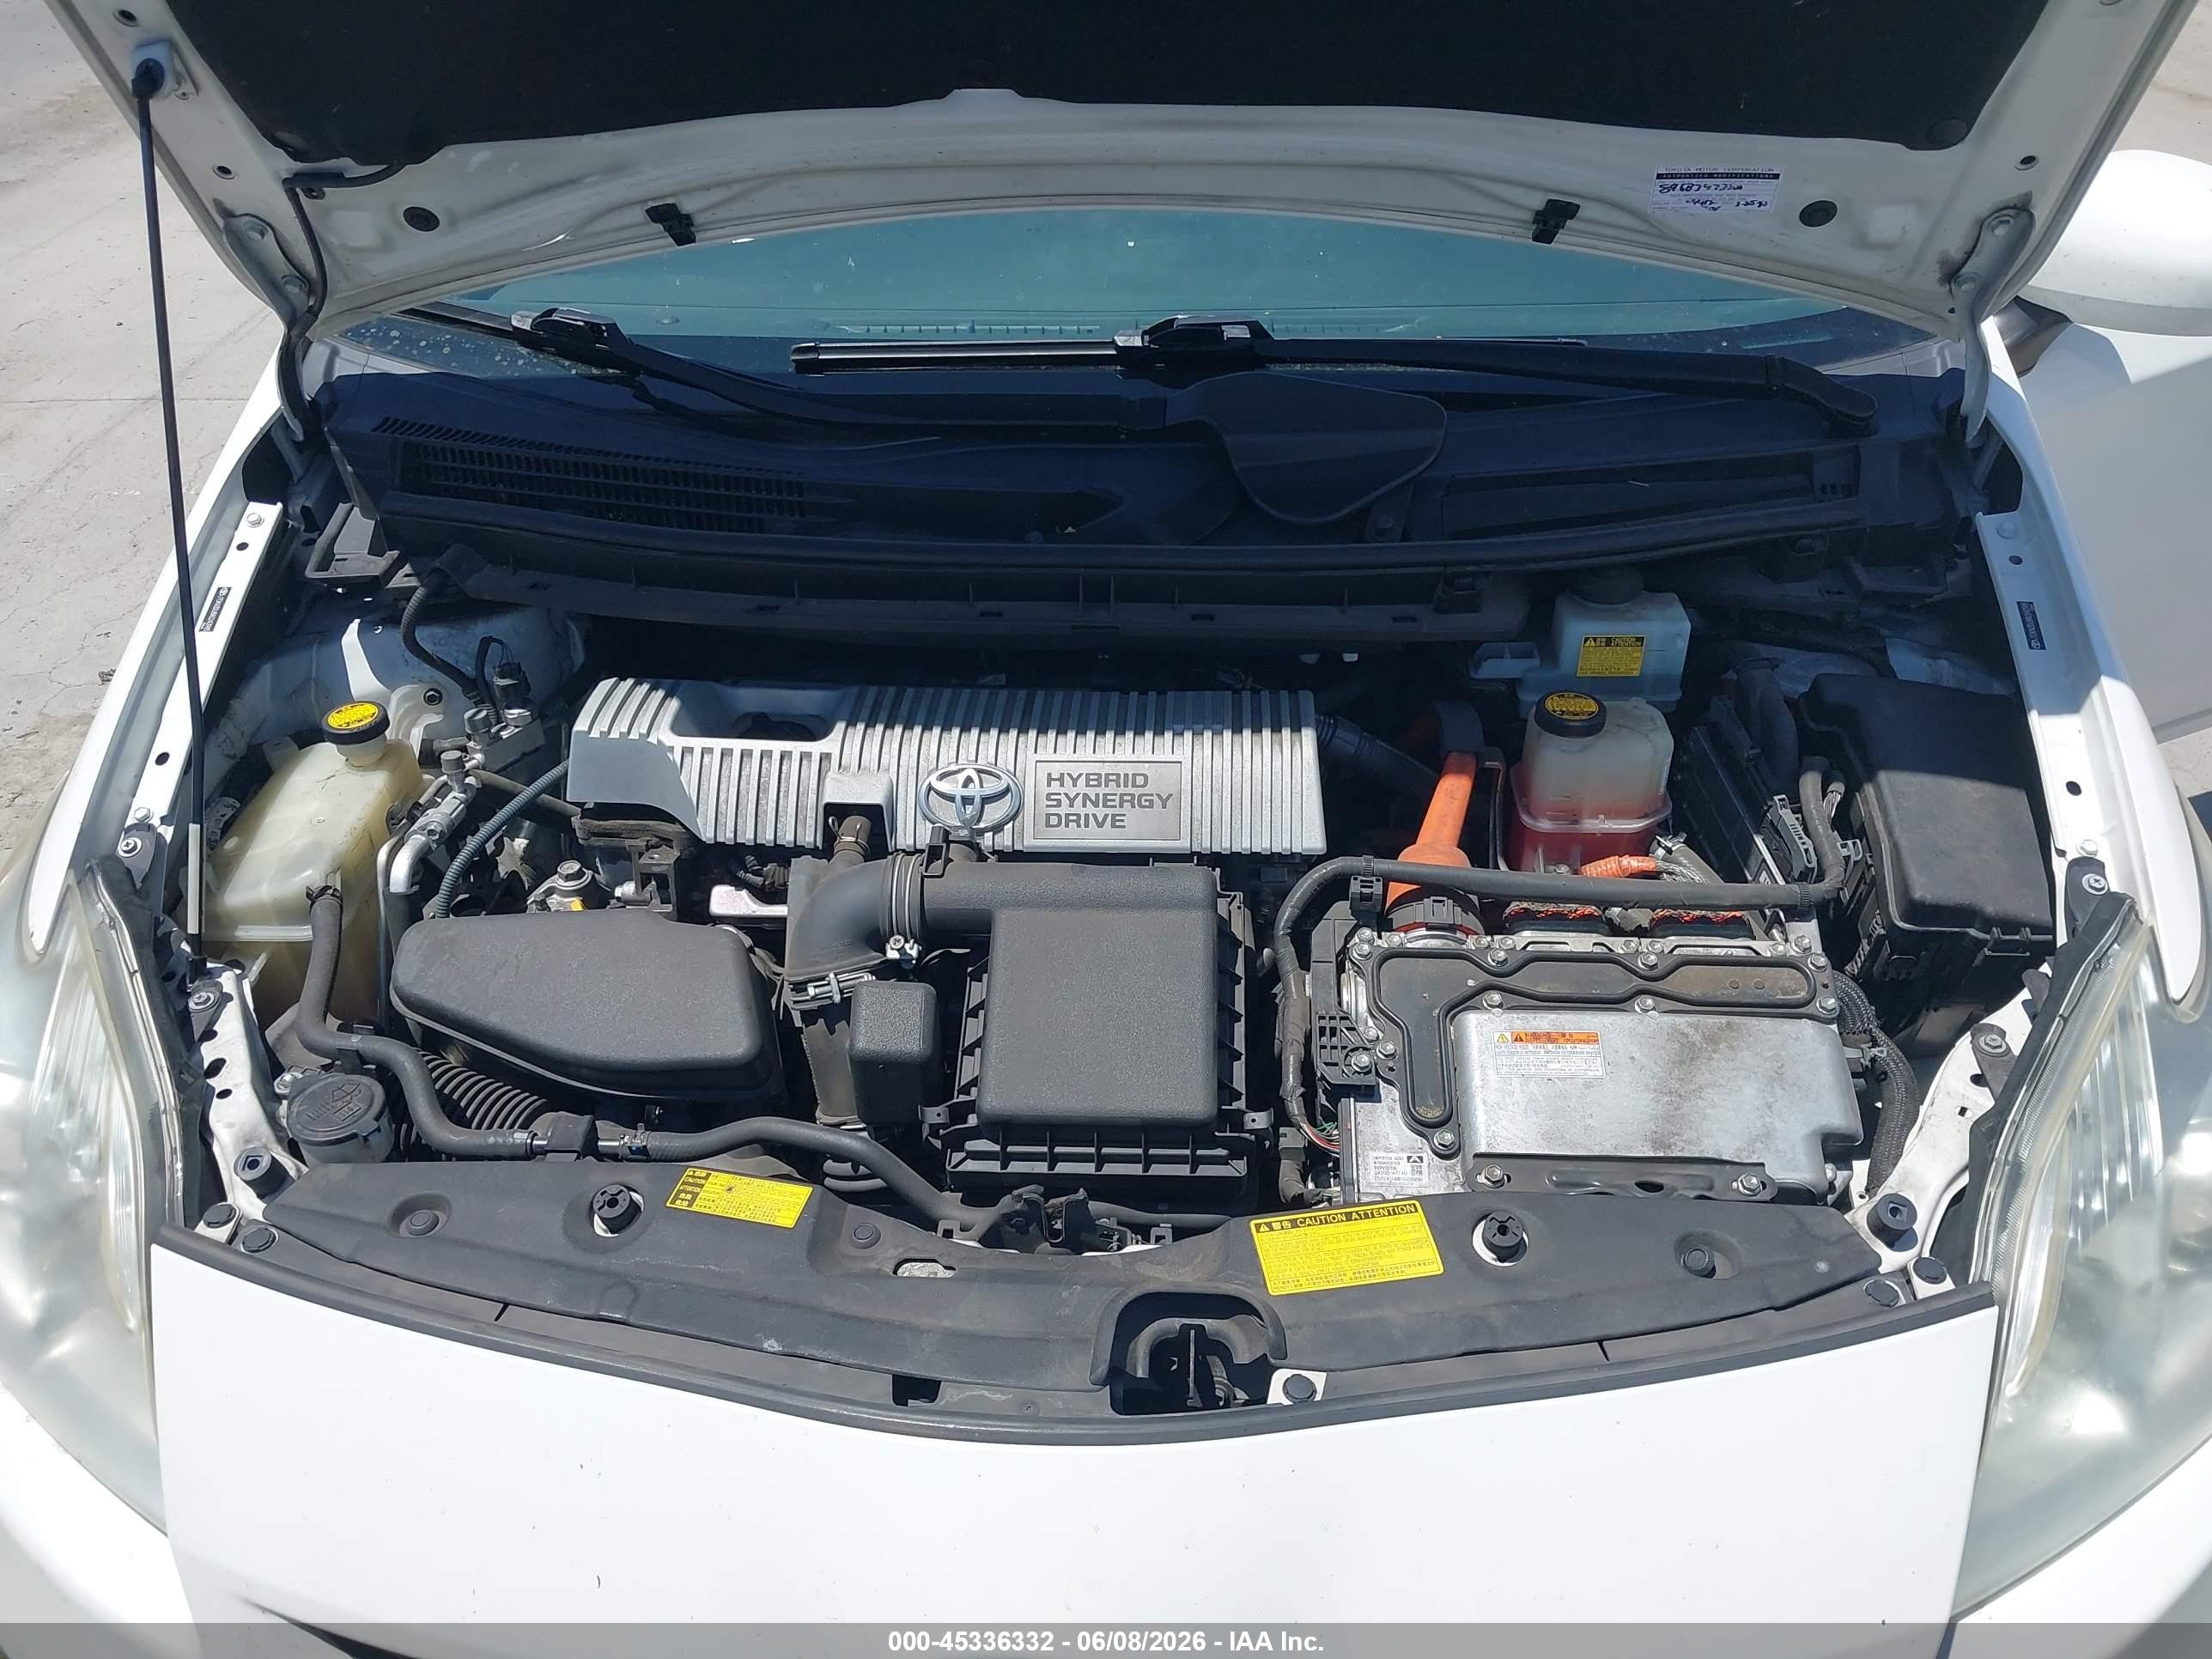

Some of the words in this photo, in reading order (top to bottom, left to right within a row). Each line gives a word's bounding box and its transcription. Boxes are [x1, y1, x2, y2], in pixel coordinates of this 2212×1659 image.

[1046, 773, 1148, 788] HYBRID
[1045, 793, 1174, 809] SYNERGY
[1045, 813, 1127, 829] DRIVE
[684, 1176, 708, 1185] CAUTION
[1297, 1213, 1346, 1227] CAUTION
[1352, 1204, 1416, 1220] ATTENTION
